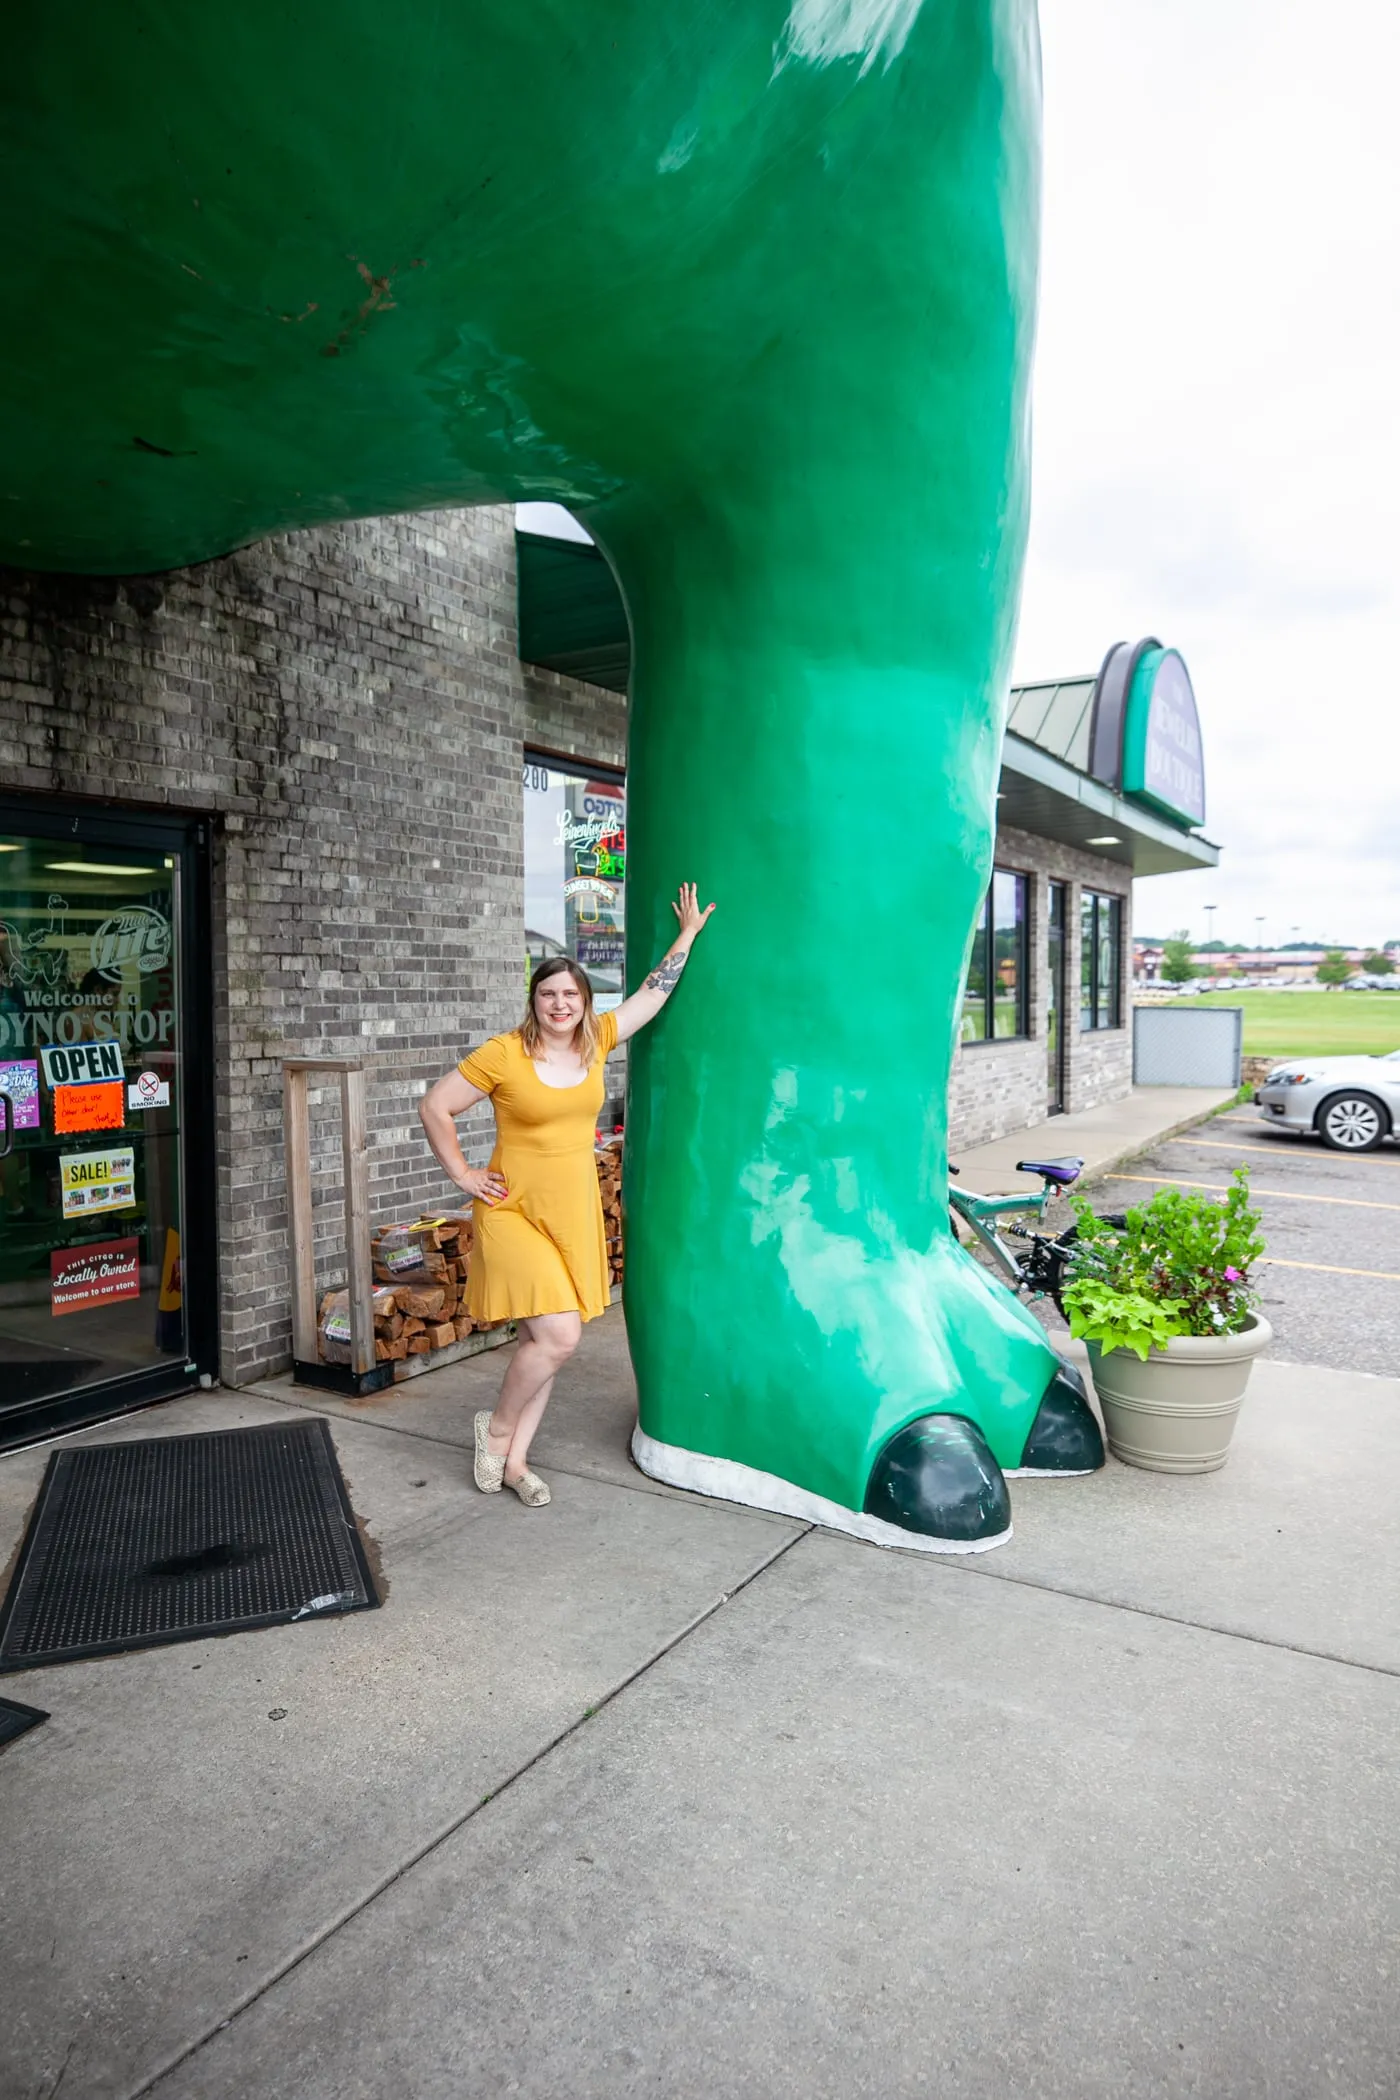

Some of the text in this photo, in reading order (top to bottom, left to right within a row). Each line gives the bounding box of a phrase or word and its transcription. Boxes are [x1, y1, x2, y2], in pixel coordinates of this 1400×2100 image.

[24, 990, 114, 1007] Welcome
[93, 1010, 177, 1047] STOP
[49, 1045, 119, 1083] OPEN
[62, 1091, 87, 1106] Please
[131, 1100, 167, 1108] SMOKING
[71, 1161, 108, 1182] SALE!
[53, 1258, 136, 1287] Locally Owned
[67, 1253, 124, 1271] THIS CITGO IS
[54, 1292, 89, 1304] Welcome
[101, 1286, 114, 1294] our
[115, 1281, 137, 1290] store.
